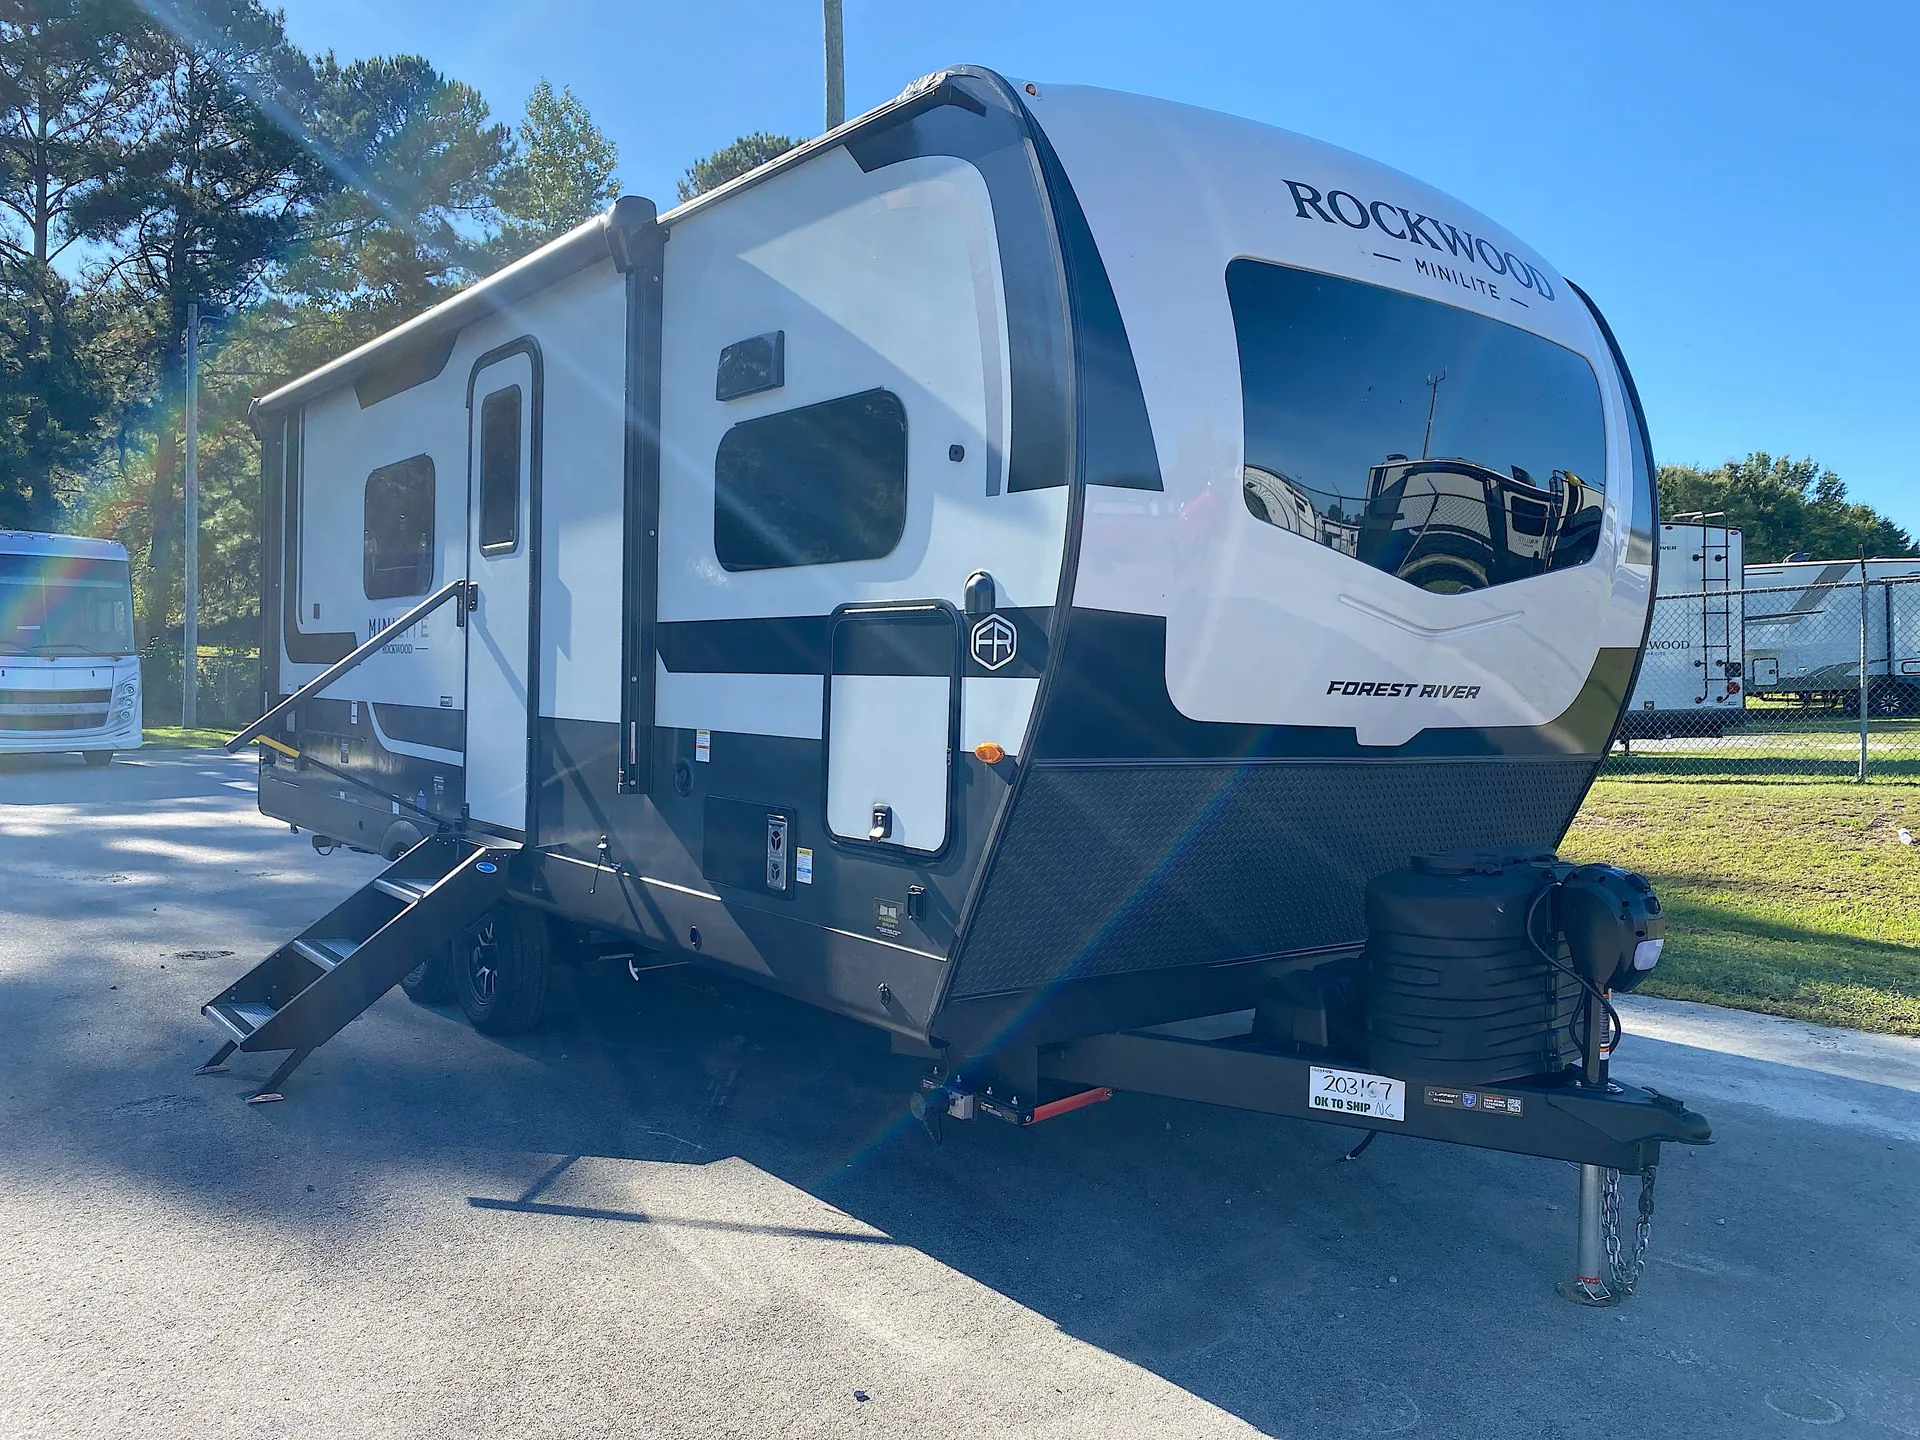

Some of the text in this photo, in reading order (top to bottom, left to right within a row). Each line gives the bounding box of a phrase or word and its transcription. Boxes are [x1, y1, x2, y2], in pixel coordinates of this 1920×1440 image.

[1281, 178, 1556, 302] ROCKWOOD
[1414, 257, 1501, 301] MINILITE
[1647, 640, 1690, 650] WOOD
[1326, 680, 1482, 699] FOREST RIVER
[1314, 1095, 1371, 1113] OK TO SHIP
